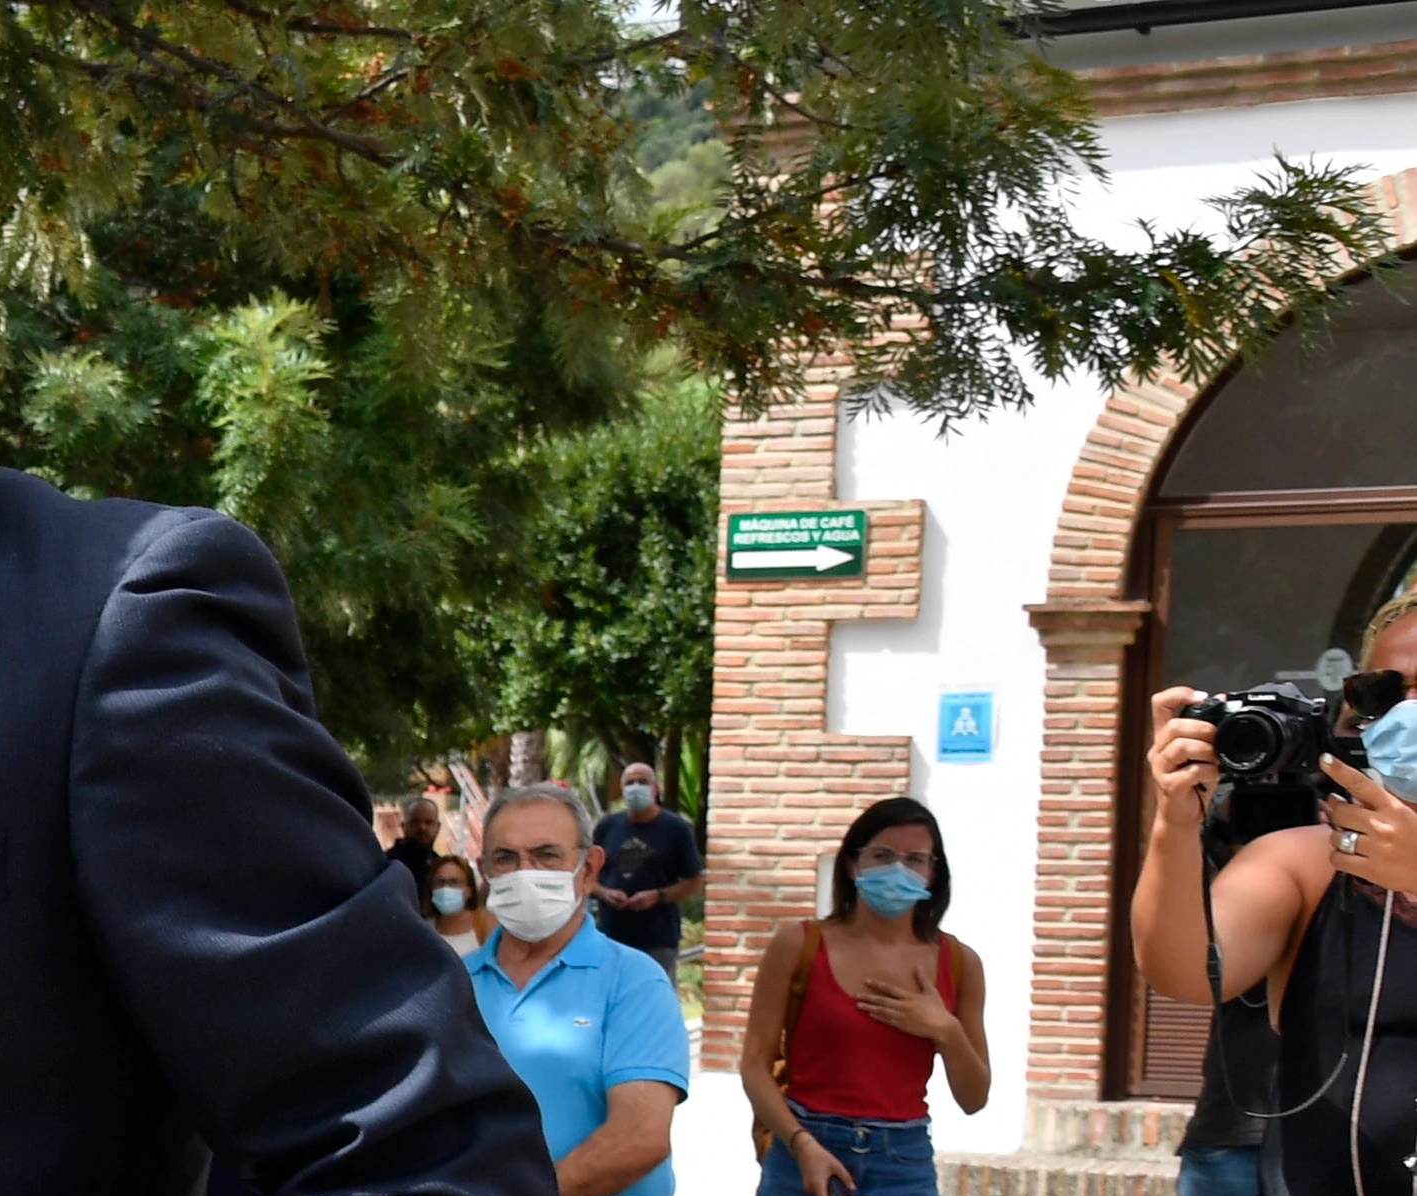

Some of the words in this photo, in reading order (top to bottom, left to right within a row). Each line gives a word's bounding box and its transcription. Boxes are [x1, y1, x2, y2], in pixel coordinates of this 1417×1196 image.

[739, 517, 798, 531] MÁQUINA
[799, 517, 819, 530] DE
[820, 514, 855, 529] CAFÉ
[733, 531, 811, 545] REFRESCOS
[812, 530, 822, 542] Y
[821, 528, 861, 542] AGUA
